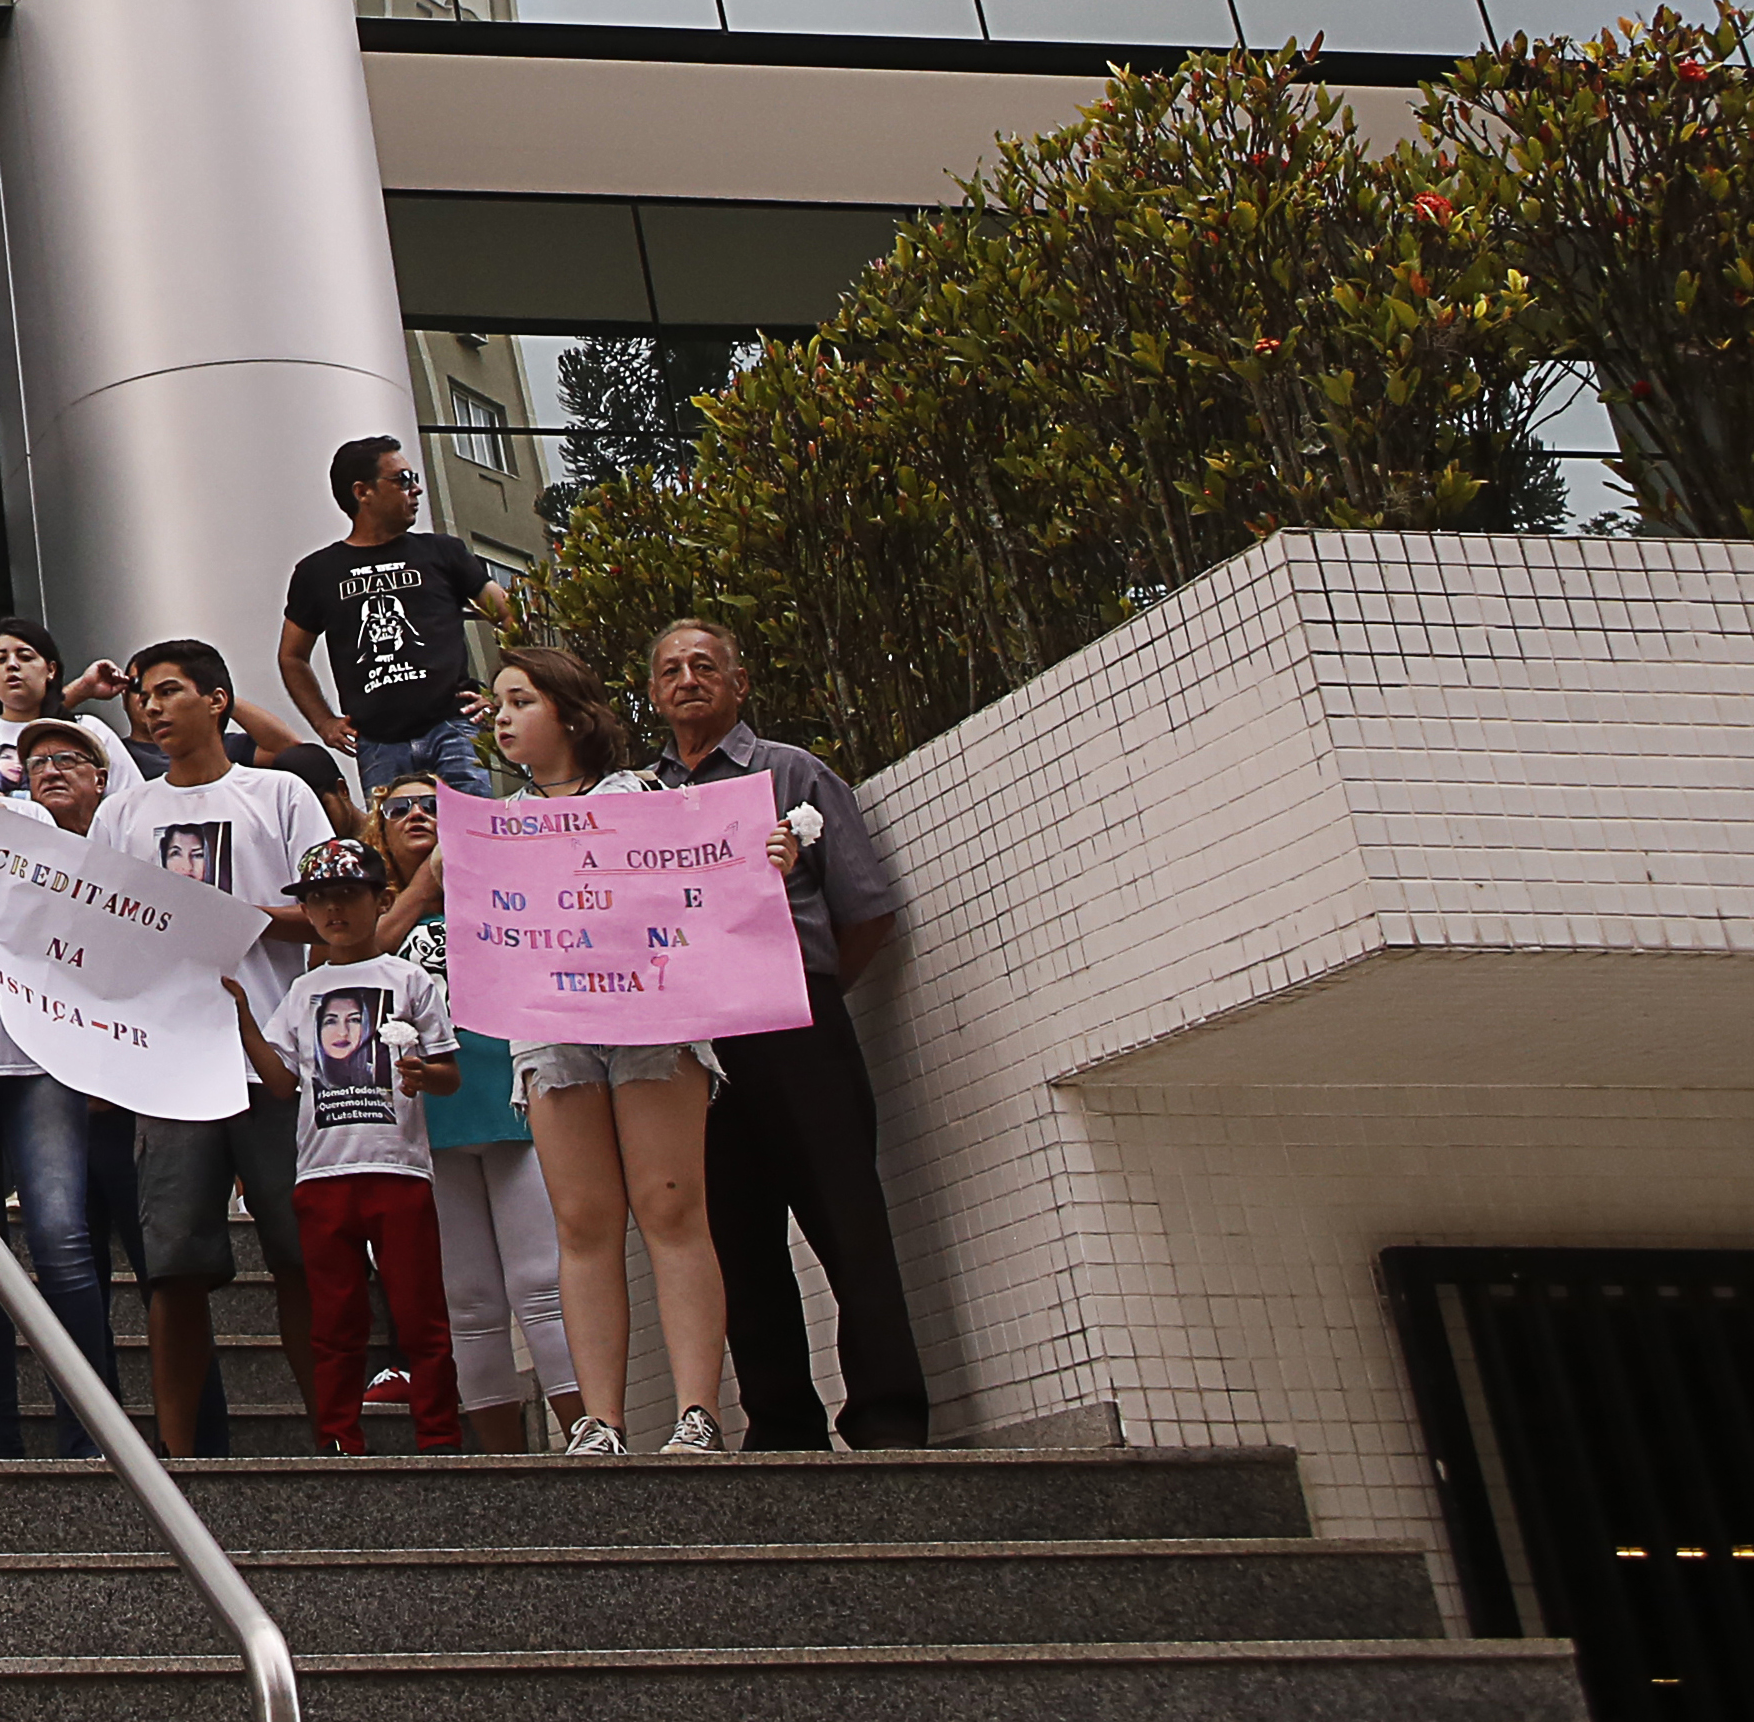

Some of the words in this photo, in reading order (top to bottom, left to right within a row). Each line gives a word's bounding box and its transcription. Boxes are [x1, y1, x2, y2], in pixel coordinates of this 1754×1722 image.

[339, 569, 422, 600] DAD
[350, 566, 373, 576] THE
[364, 670, 427, 694] GALAXIES
[368, 666, 383, 679] OF
[388, 662, 414, 674] ALL
[491, 811, 599, 836] ROSAIRA
[582, 850, 598, 869] A
[626, 839, 734, 869] COPEIRA
[492, 889, 526, 911] NO
[558, 883, 613, 910] CÉU
[684, 888, 703, 908] E
[476, 922, 593, 953] JUSTIÇA
[648, 927, 690, 948] NA
[46, 937, 85, 968] NA
